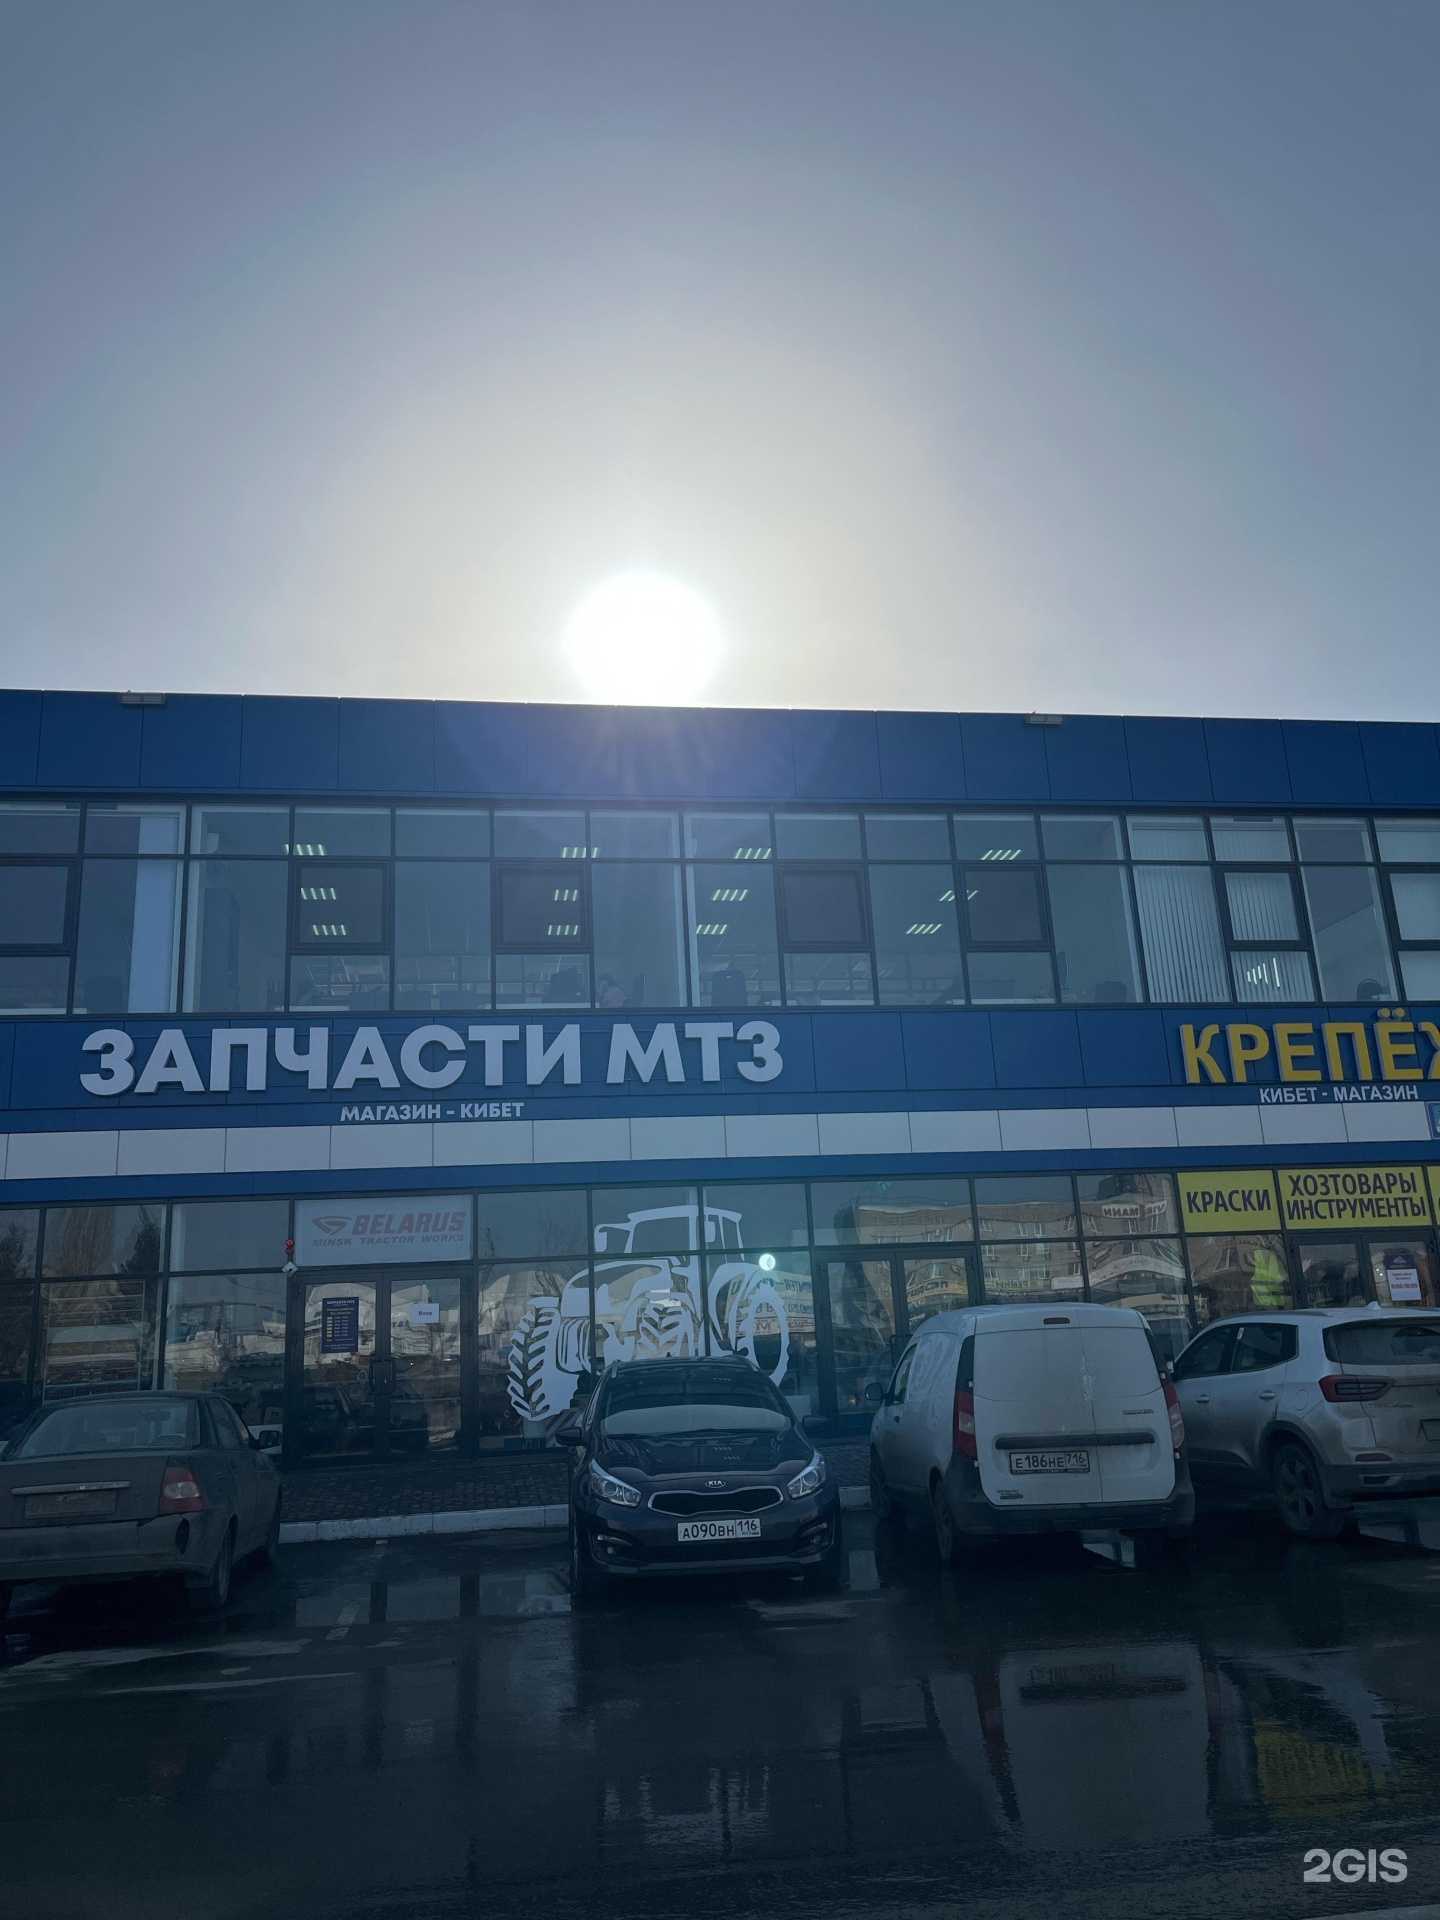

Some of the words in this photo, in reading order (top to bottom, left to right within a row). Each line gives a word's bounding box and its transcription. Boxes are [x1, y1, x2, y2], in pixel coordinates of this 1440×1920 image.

[80, 1023, 582, 1096] ЗАПЧАСТИ
[606, 1020, 784, 1083] МТЗ
[1259, 1086, 1318, 1103] КИБЕТ
[1332, 1085, 1419, 1102] МАГАЗИН
[340, 1104, 441, 1122] МАГАЗИН
[460, 1102, 525, 1119] КИБЕТ
[1287, 1171, 1417, 1197] ХОЗТОВАРЫ
[1186, 1188, 1272, 1213] КРАСКИ
[1286, 1196, 1427, 1221] ИНСТРУМЕНТЫ
[351, 1211, 467, 1236] BELARUS
